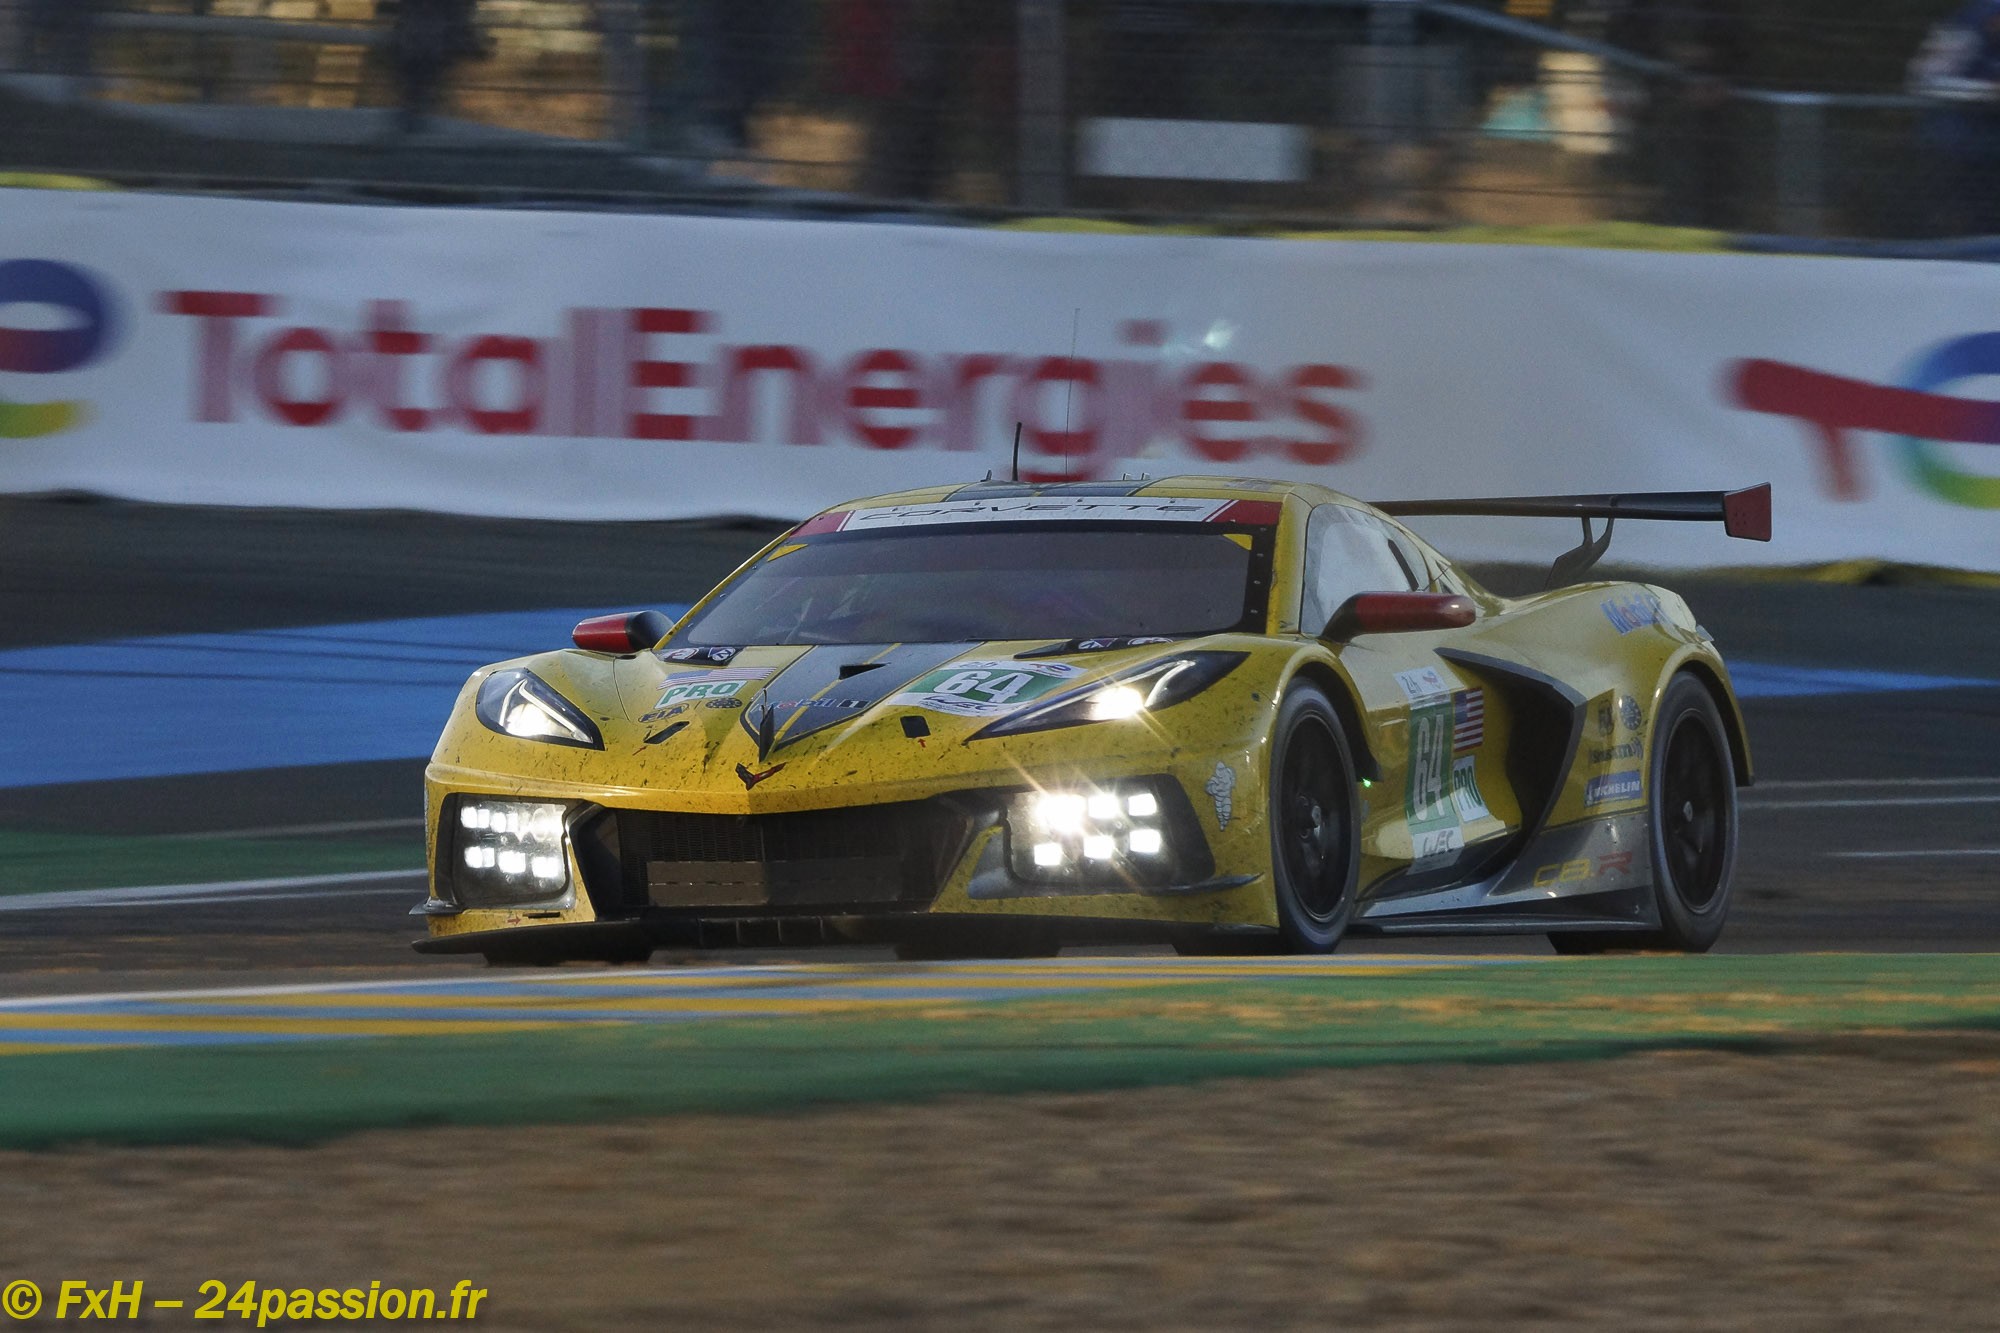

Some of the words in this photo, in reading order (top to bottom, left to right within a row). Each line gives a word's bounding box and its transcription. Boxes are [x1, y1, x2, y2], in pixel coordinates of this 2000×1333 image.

[158, 290, 1362, 482] TotalEnergies
[858, 502, 1205, 521] CORVETTE
[660, 682, 738, 705] PRO
[933, 670, 1034, 703] 64
[1413, 714, 1445, 821] 64
[1453, 766, 1482, 811] PRO
